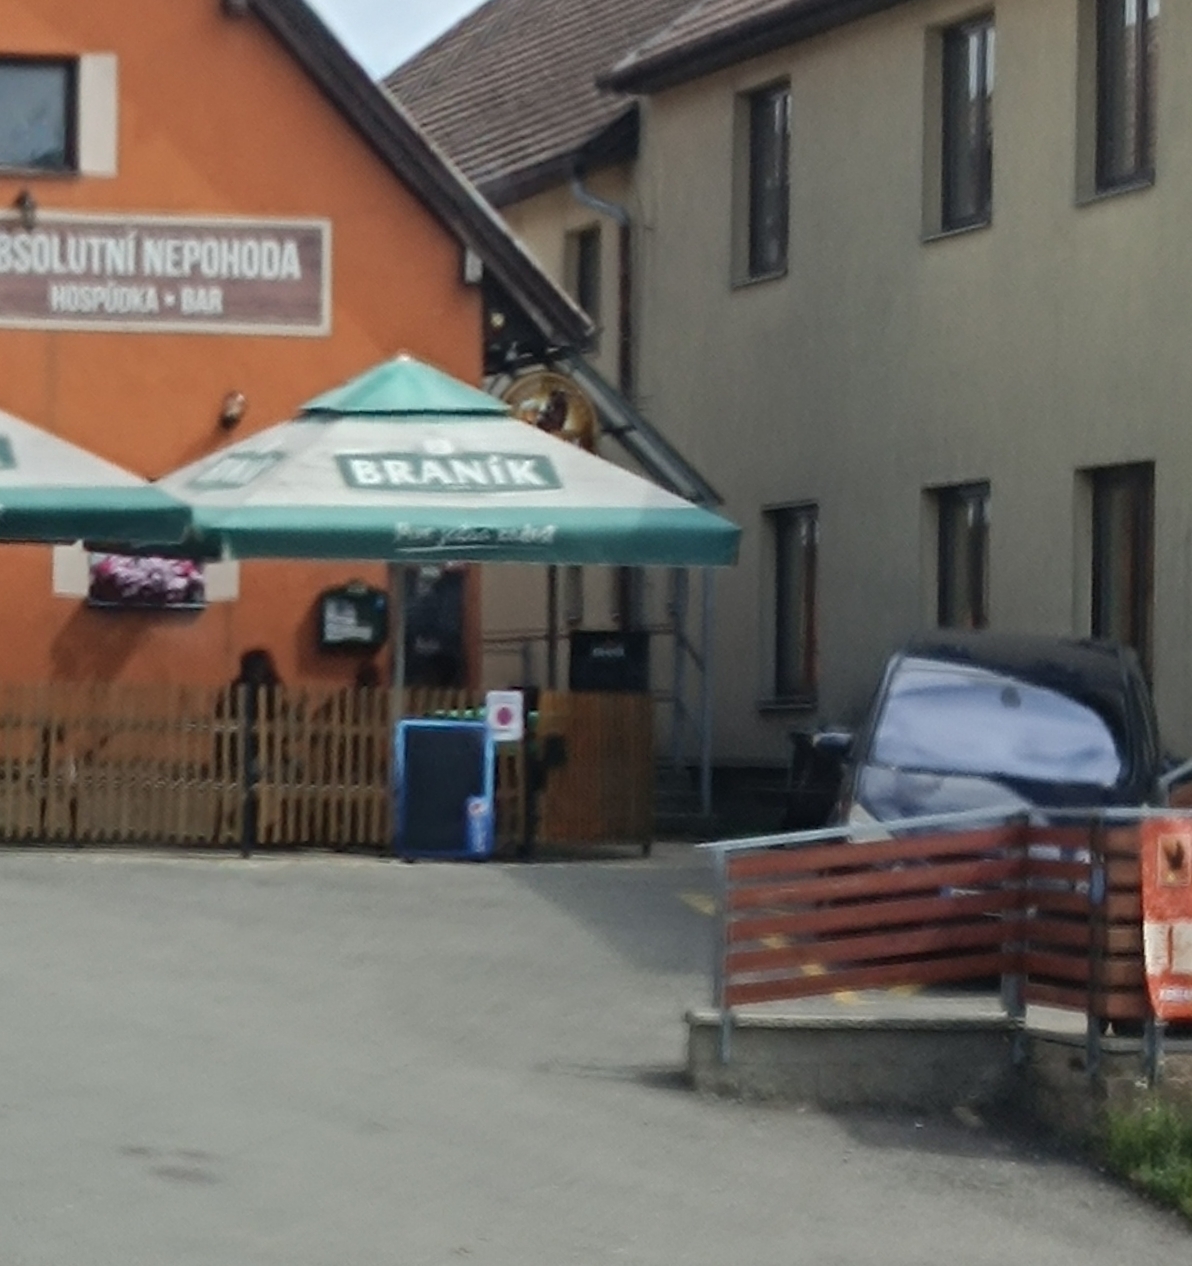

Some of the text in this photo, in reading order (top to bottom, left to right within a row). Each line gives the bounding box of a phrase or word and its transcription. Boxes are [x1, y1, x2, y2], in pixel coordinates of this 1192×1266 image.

[142, 237, 302, 281] NEPOHODA
[180, 285, 224, 315] BAR
[349, 454, 551, 485] BRANÍK
